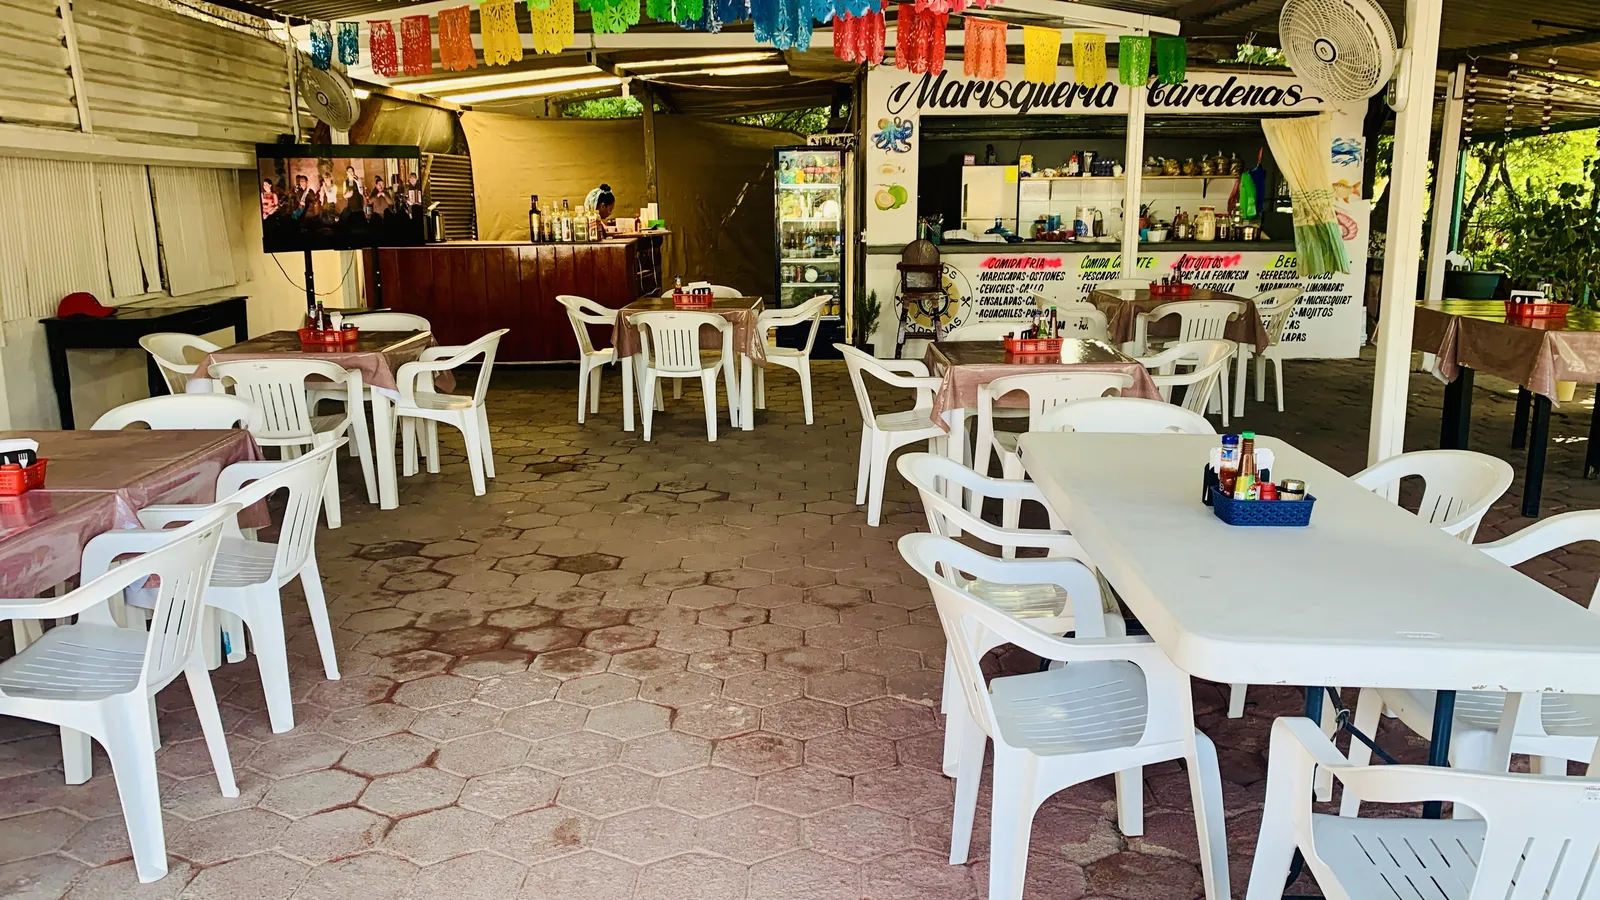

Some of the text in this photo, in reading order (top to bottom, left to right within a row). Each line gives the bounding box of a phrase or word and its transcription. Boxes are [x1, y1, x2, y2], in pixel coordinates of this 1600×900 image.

[988, 257, 1021, 269] COMIDA
[1080, 255, 1110, 269] COMIDA
[979, 271, 1066, 281] MARISCADAS OSTIONES
[1201, 271, 1211, 280] LA
[1211, 270, 1249, 280] FRANCESA
[979, 284, 1014, 294] CEVICHES
[1305, 283, 1344, 293] LIMONADAS
[979, 296, 1024, 306] ENSALADAS
[978, 308, 1023, 319] AGUACHILES
[1298, 307, 1334, 319] MOJITOS
[1280, 332, 1307, 342] LADAS
